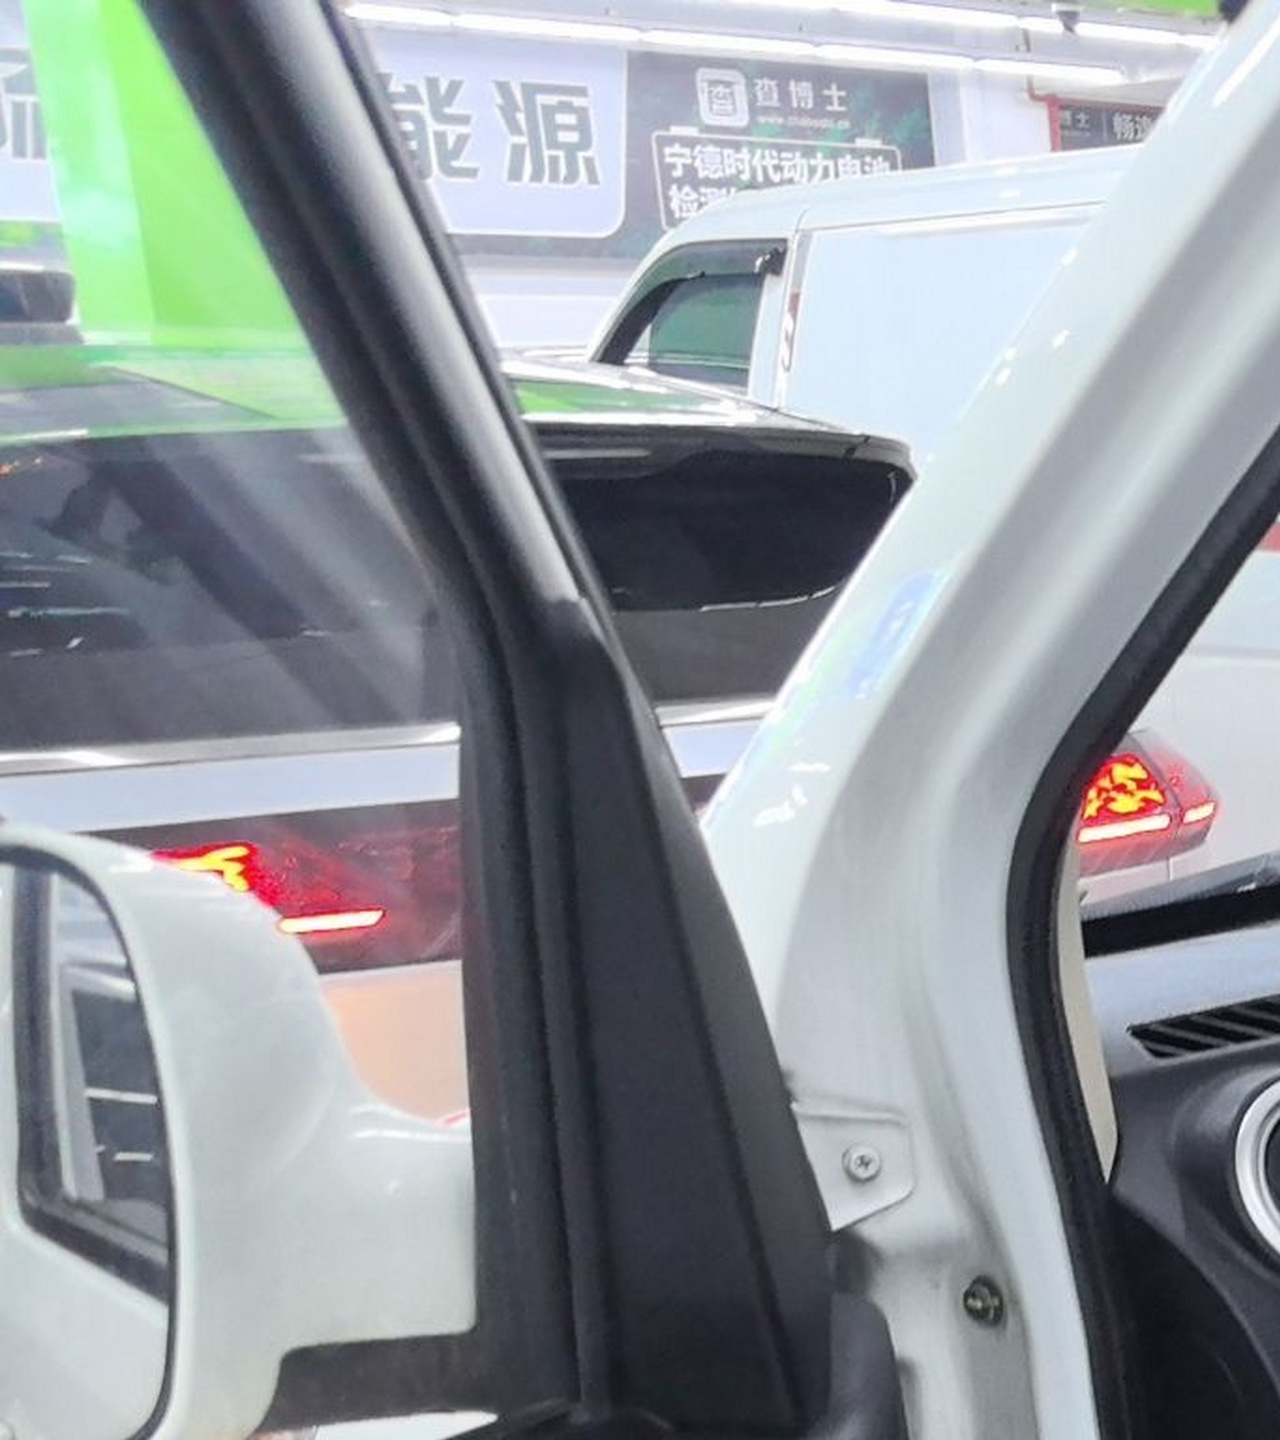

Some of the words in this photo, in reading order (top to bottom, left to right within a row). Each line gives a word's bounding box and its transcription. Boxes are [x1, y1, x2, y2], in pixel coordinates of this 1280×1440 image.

[379, 72, 601, 187] 能源
[754, 78, 848, 112] 查博士
